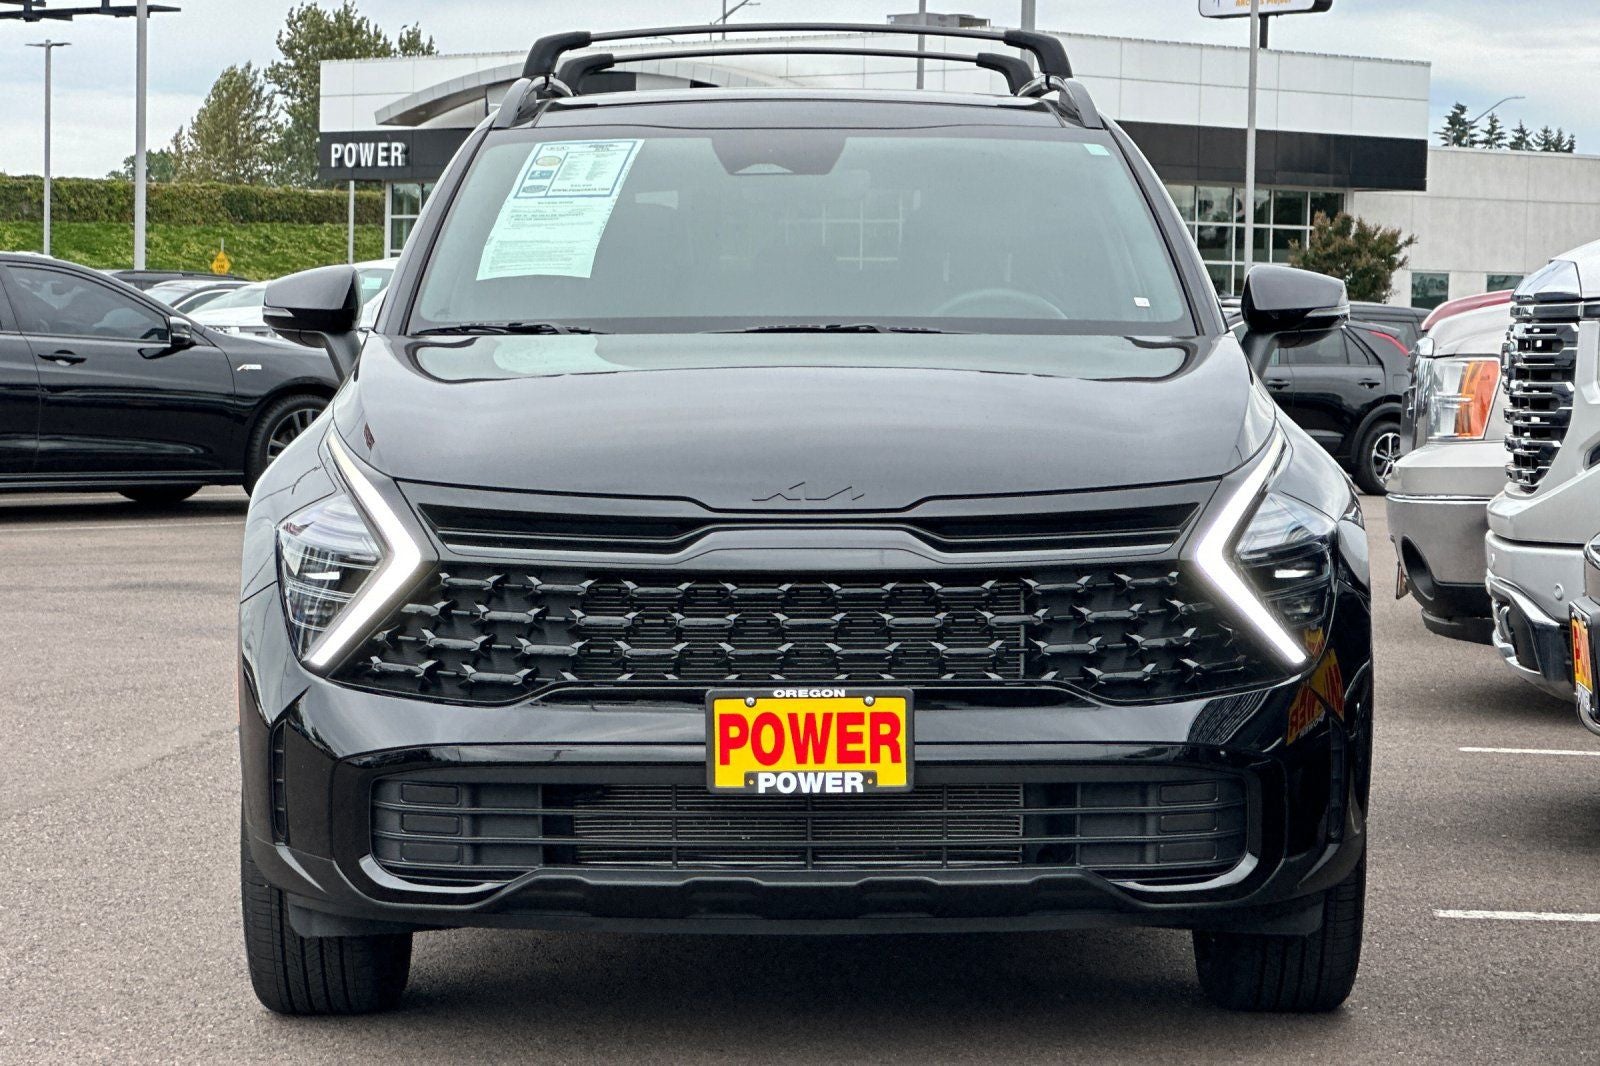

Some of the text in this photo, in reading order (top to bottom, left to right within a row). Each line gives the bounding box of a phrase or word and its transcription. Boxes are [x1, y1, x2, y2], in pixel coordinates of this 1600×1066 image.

[331, 142, 404, 168] POWER
[772, 689, 846, 698] OREGON
[718, 711, 902, 766] POWER
[757, 772, 864, 794] POWER
